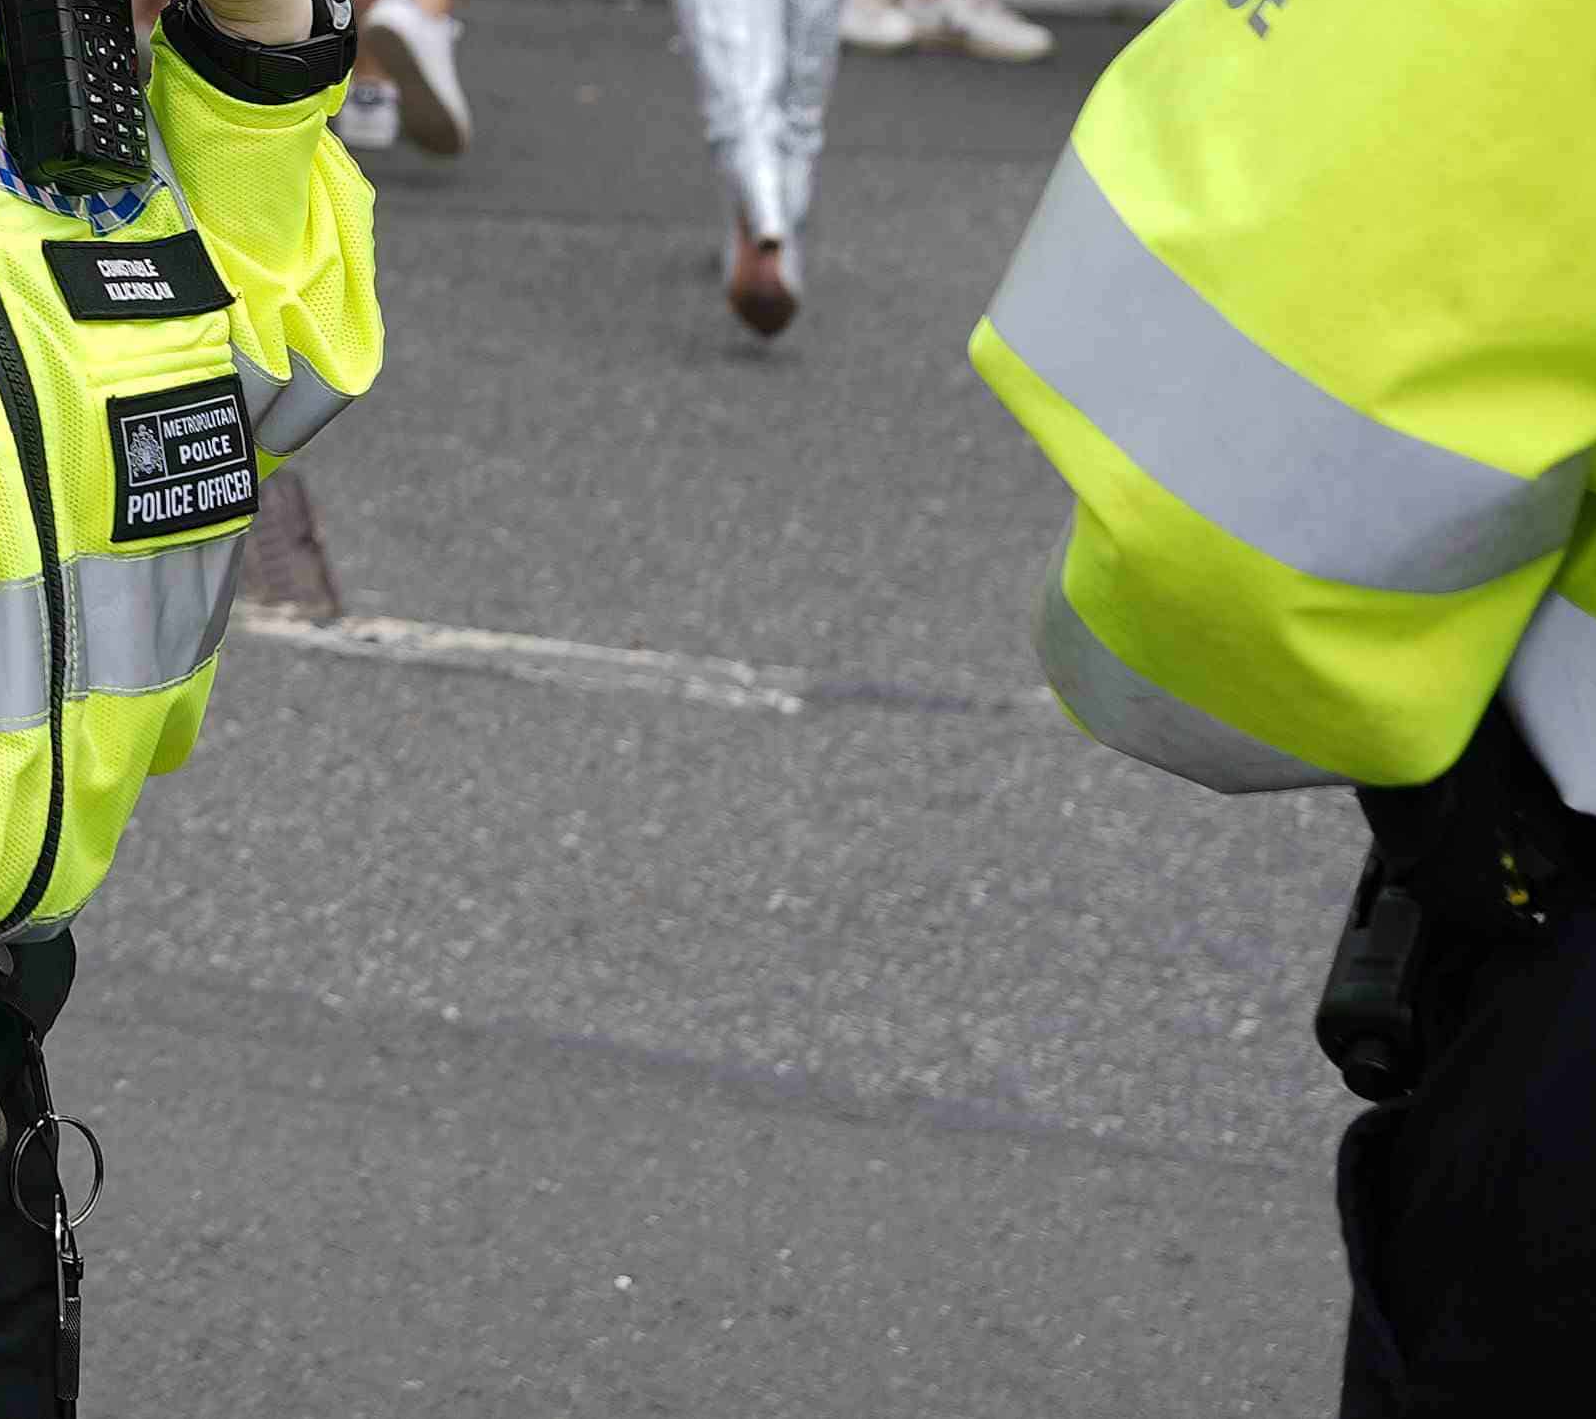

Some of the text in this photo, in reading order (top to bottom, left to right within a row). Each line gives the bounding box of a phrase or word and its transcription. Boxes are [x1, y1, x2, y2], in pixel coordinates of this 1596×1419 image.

[163, 405, 237, 440] METROPOLITAN
[179, 434, 233, 466] POLICE
[127, 469, 253, 525] POLICE OFFICER
